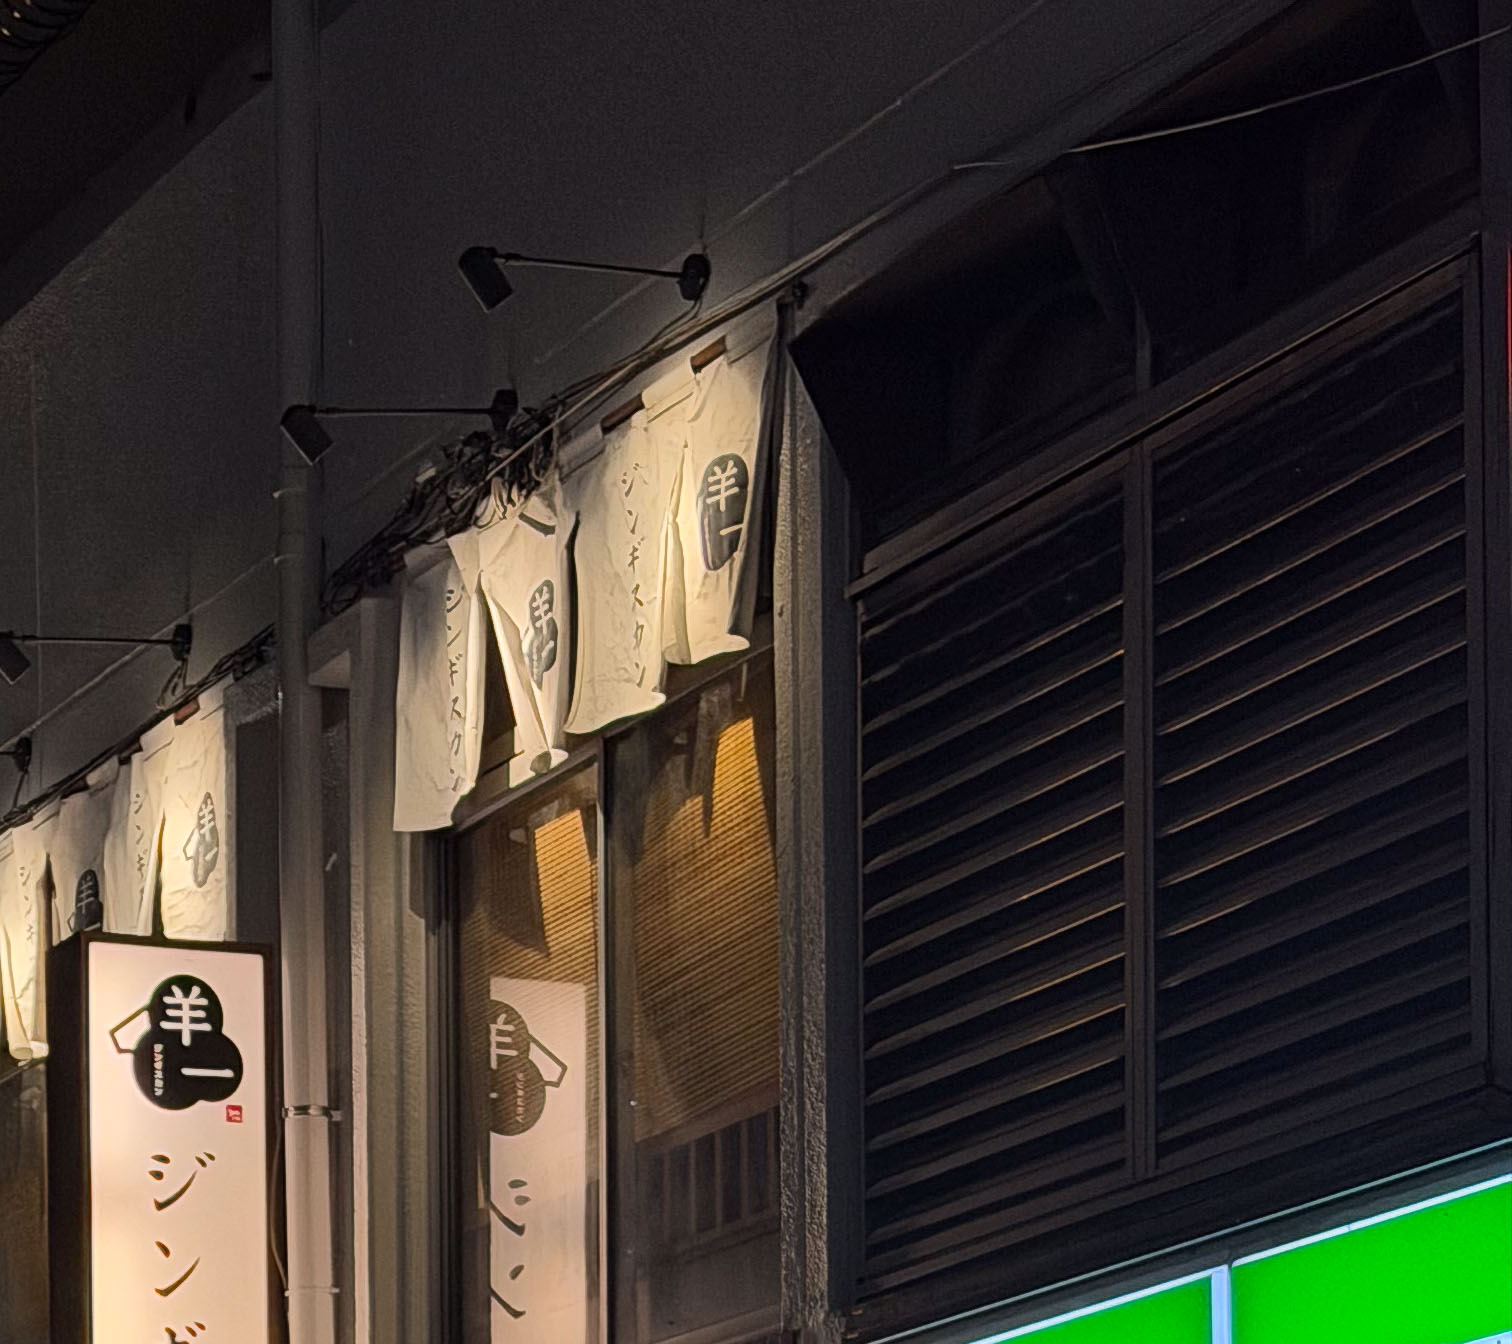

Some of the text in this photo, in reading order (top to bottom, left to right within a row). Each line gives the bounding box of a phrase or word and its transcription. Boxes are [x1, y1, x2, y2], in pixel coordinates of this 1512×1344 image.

[704, 460, 744, 538] 羊一
[620, 462, 648, 690] ジンギスカン
[443, 585, 466, 793] ジンギスカン
[159, 985, 234, 1077] 羊一
